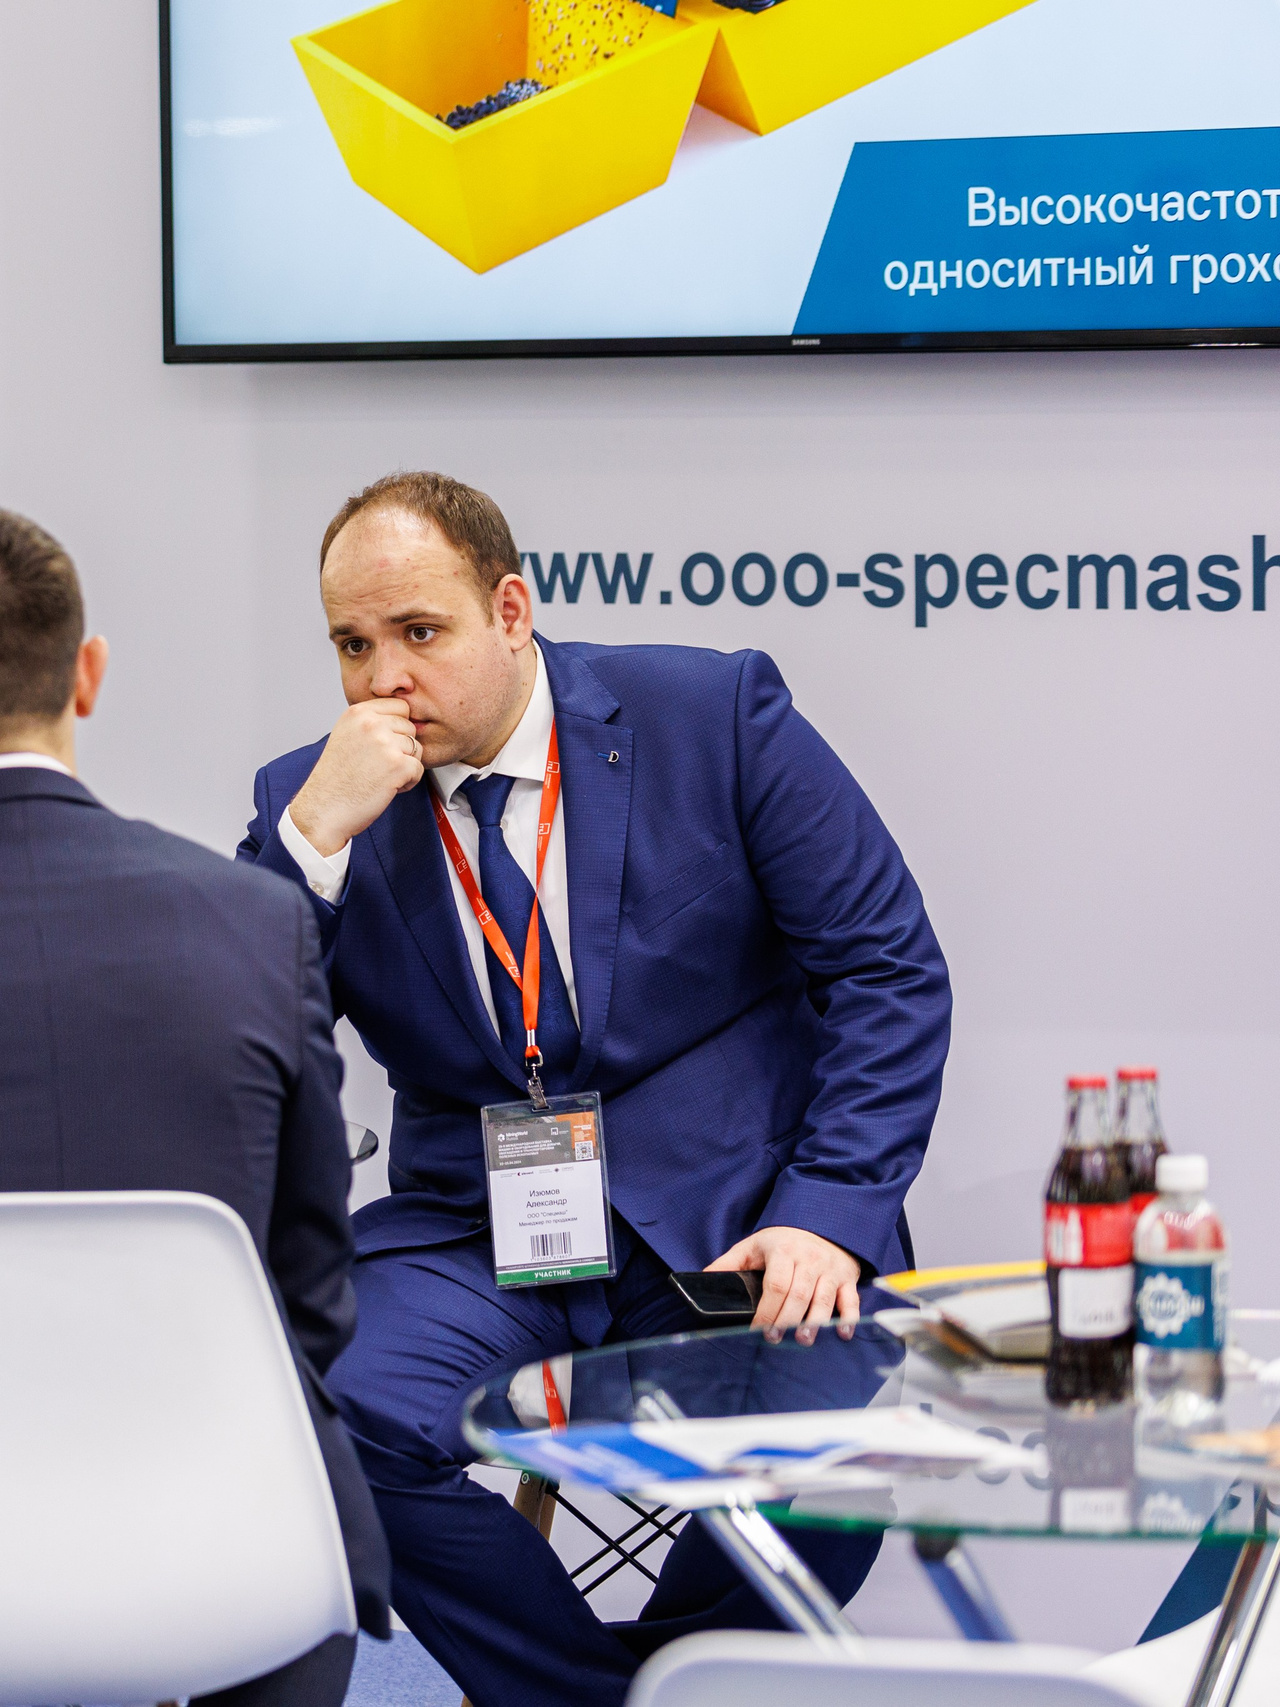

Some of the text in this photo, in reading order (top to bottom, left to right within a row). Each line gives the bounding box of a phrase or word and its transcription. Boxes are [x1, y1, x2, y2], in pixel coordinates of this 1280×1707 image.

[967, 185, 1280, 227] Высокочастот
[883, 244, 1154, 296] односитный
[519, 534, 1280, 629] ww.ooo-specmash
[526, 1198, 568, 1209] Александр
[529, 1188, 560, 1197] Изюмов
[534, 1269, 571, 1278] УЧАСТНИК
